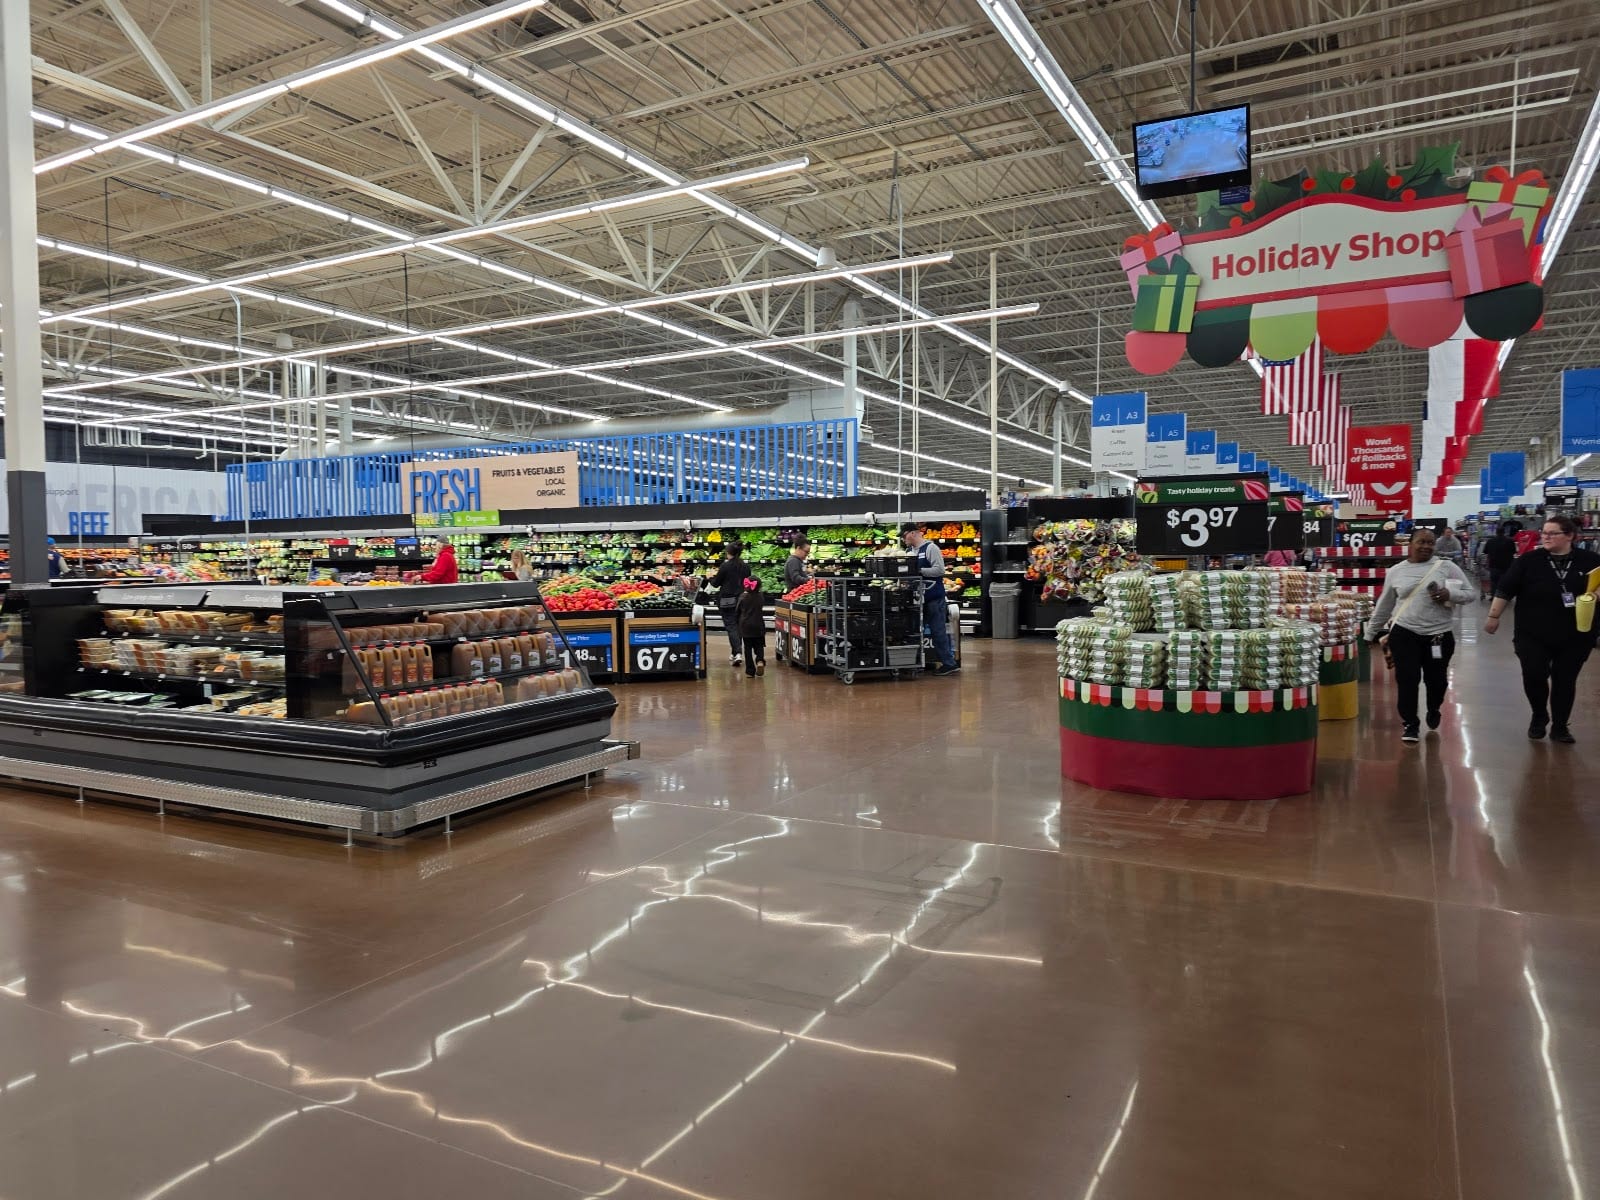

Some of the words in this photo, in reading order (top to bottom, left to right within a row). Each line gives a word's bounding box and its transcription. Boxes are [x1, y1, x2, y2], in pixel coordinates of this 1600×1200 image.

[1211, 243, 1342, 280] Holiday
[1348, 228, 1446, 262] Shop
[1099, 413, 1111, 422] A2
[1126, 411, 1138, 420] A3
[1168, 429, 1179, 437] A5
[1365, 438, 1392, 446] Wow!
[1353, 445, 1405, 454] Thousands
[1350, 455, 1361, 463] of
[1362, 453, 1407, 461] Rollbacks
[492, 469, 516, 477] FRUITS
[523, 466, 565, 476] VEGETABLES
[409, 468, 481, 513] FRESH
[46, 482, 228, 535] MERICAN
[69, 511, 109, 535] BEEF
